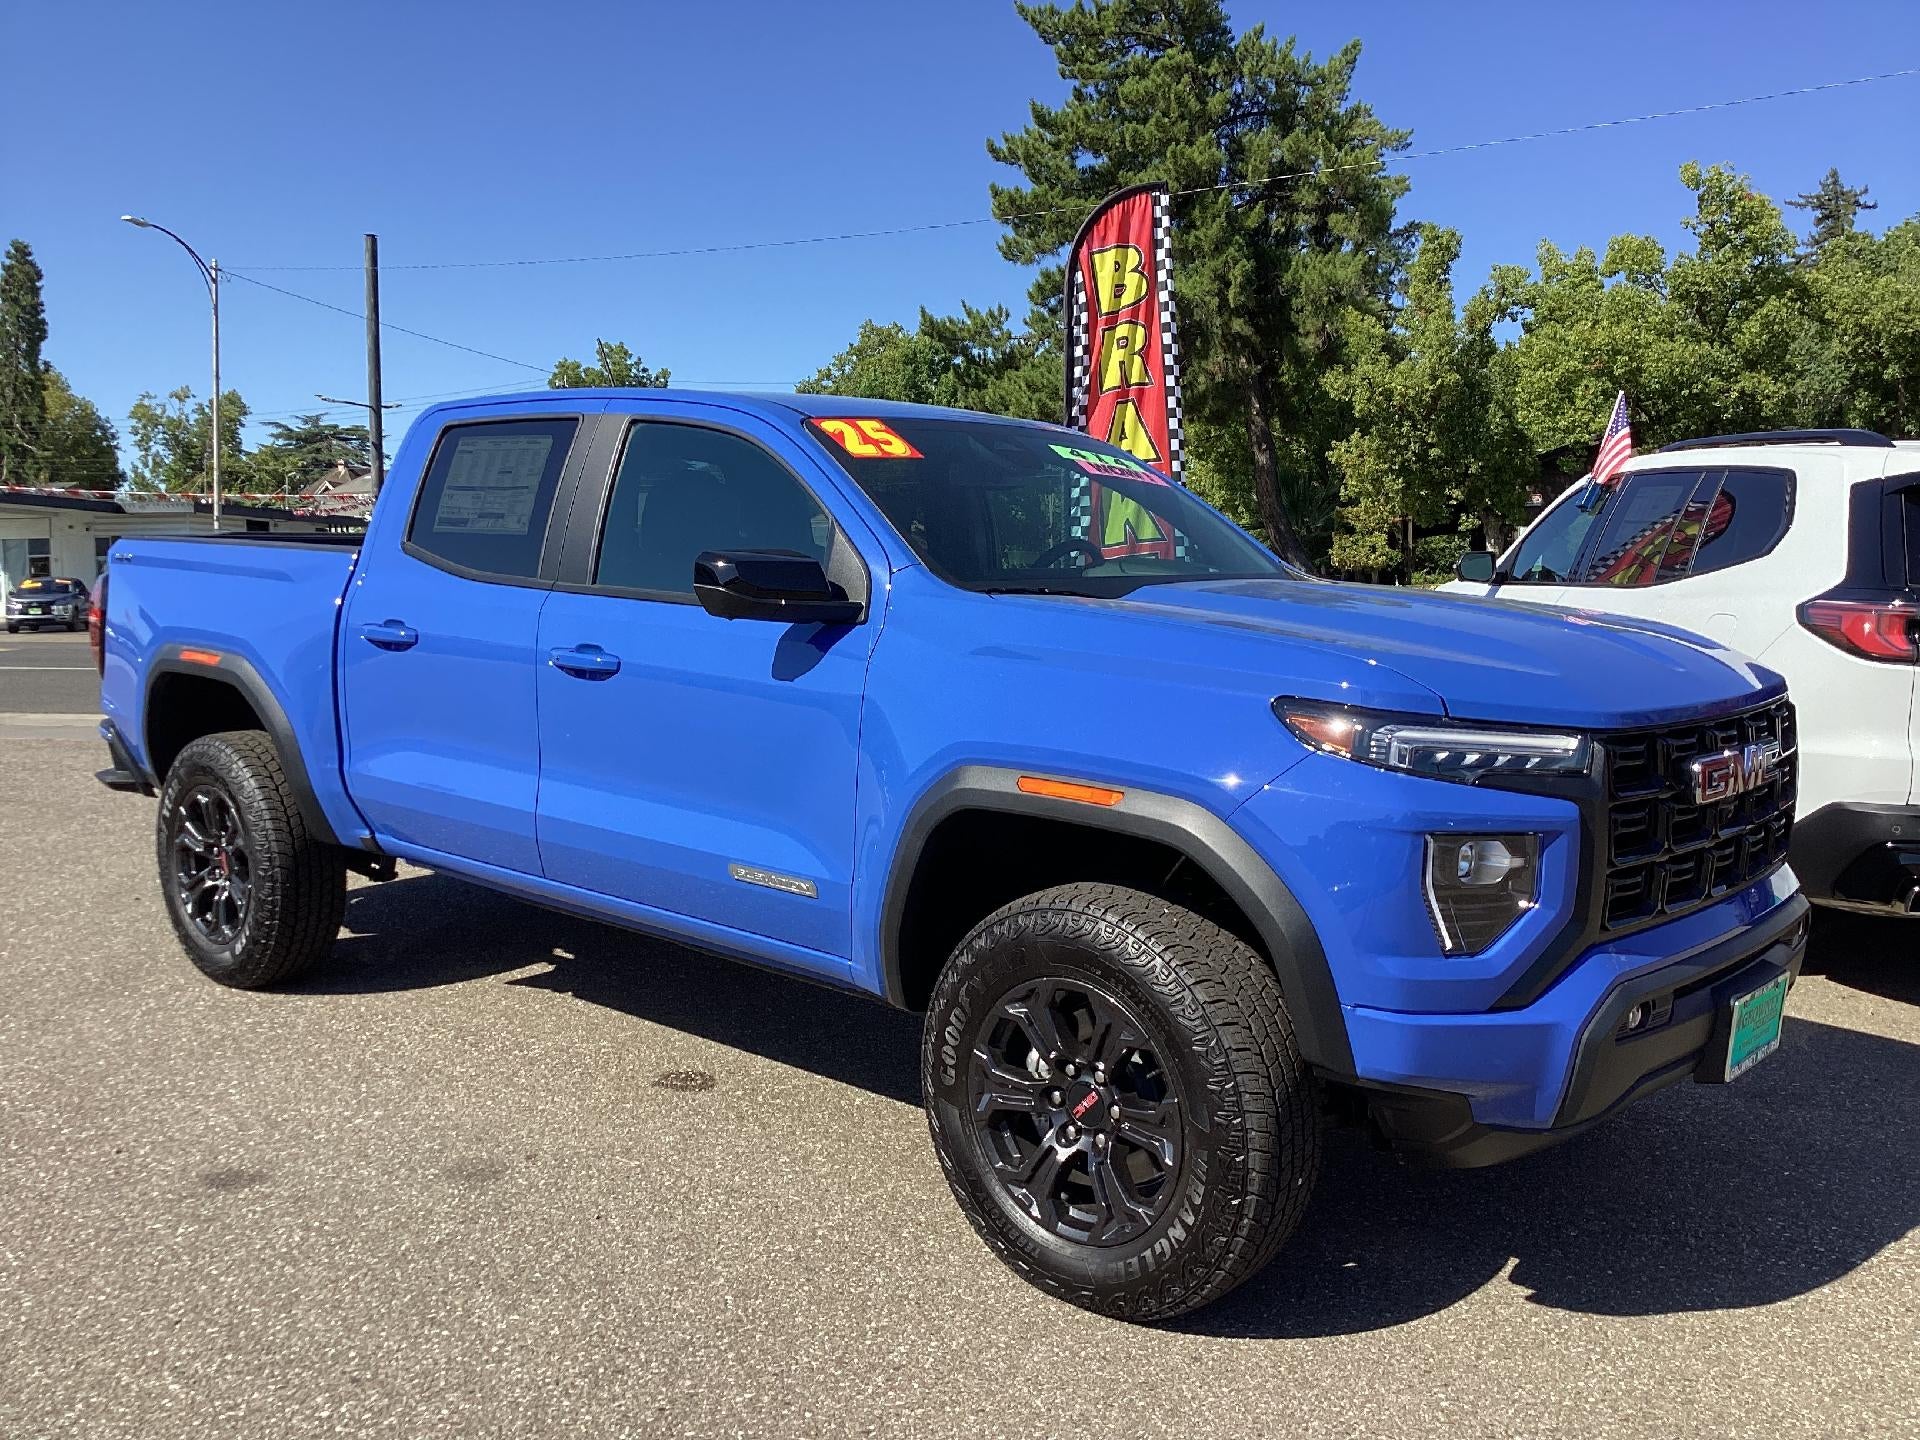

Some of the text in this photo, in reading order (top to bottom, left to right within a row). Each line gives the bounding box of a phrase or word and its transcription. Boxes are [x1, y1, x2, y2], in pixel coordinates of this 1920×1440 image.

[1090, 243, 1168, 560] BRAK
[820, 419, 912, 456] 25
[1692, 738, 1780, 804] GMC
[1072, 1090, 1099, 1119] GMC
